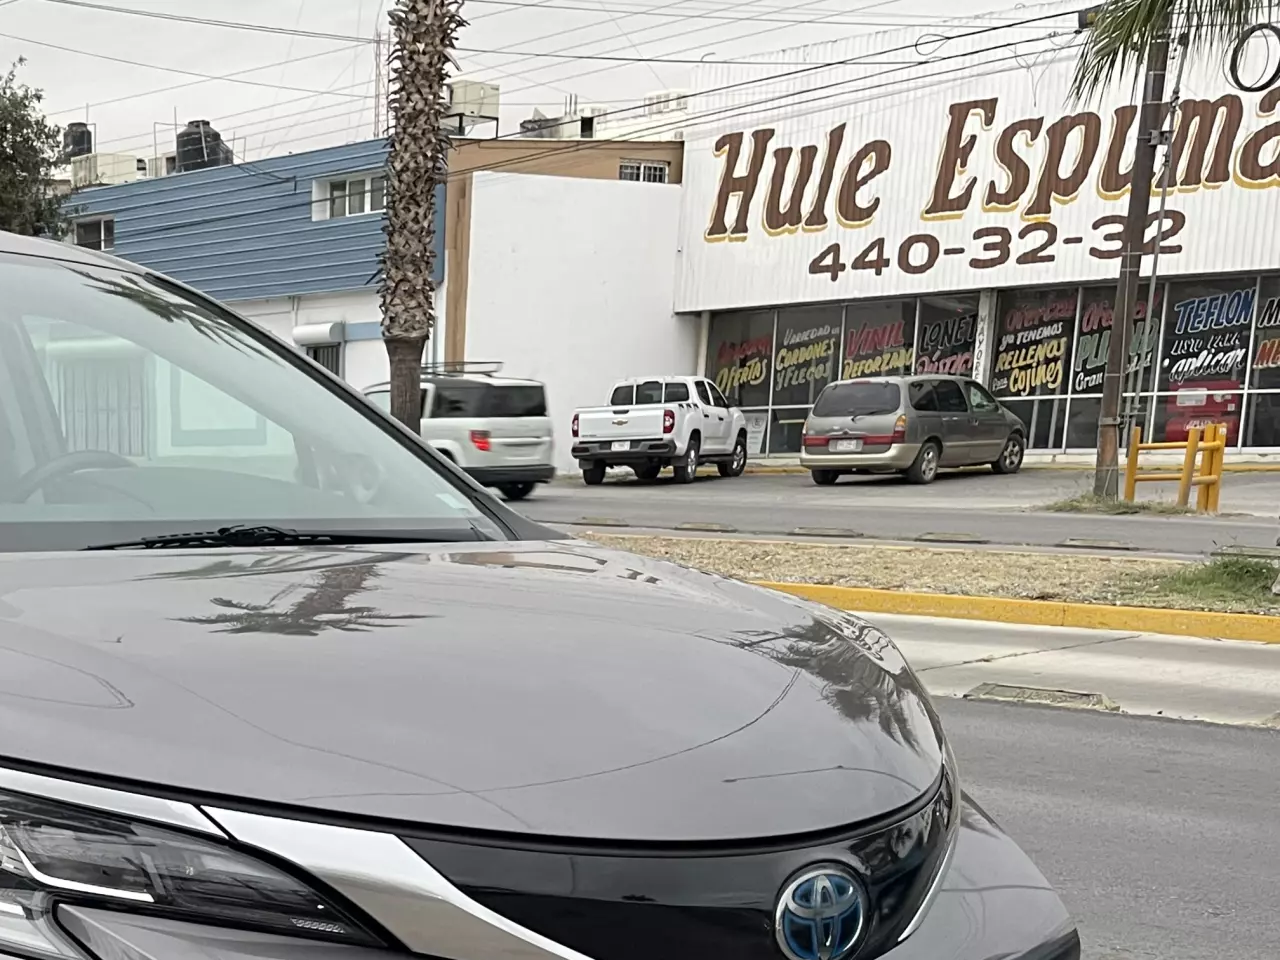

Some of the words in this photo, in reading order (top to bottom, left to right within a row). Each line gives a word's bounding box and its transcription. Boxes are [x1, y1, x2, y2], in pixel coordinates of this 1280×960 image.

[704, 122, 892, 243] Hule
[809, 209, 1186, 282] 440-32-32
[1174, 287, 1257, 334] TEFLON
[846, 320, 905, 358] VINIL
[918, 312, 978, 355] LONET
[1016, 322, 1063, 345] TENEMOS
[995, 337, 1067, 373] RELLENOS
[1169, 348, 1247, 385] aplicar
